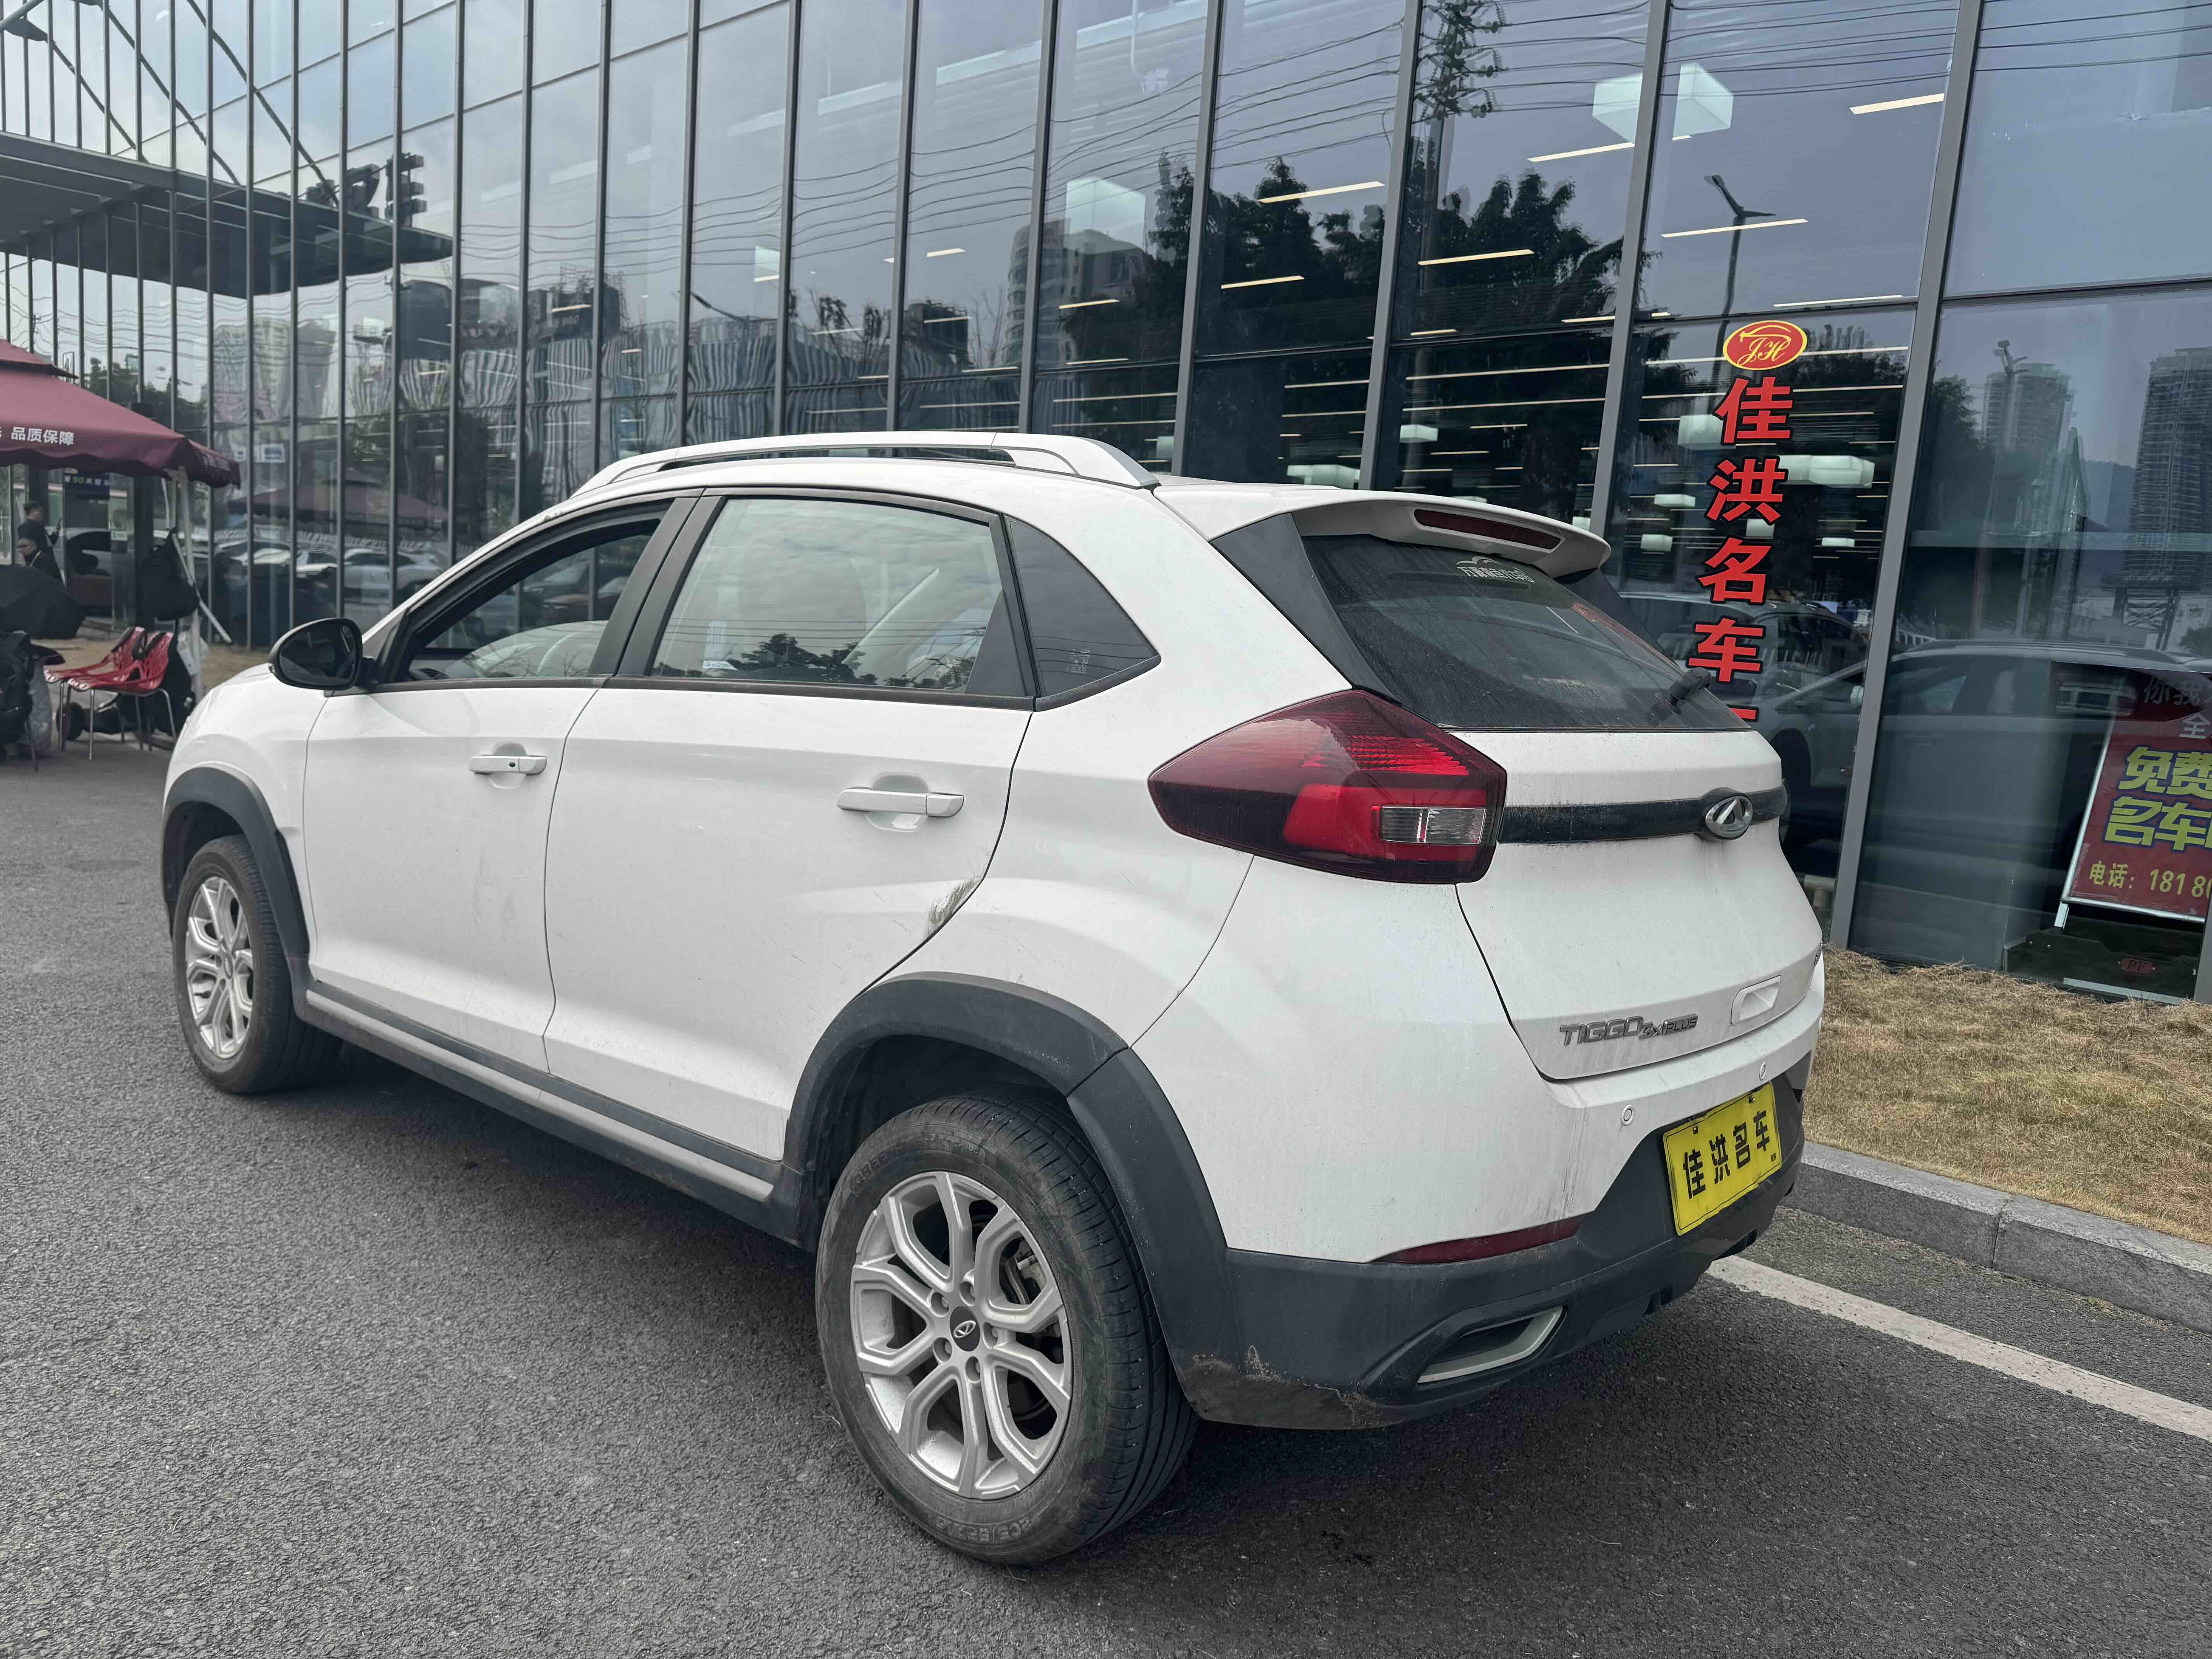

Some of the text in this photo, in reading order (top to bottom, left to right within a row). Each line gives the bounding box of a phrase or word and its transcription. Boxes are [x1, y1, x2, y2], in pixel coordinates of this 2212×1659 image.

[11, 426, 74, 445] 品质保障
[1688, 376, 1793, 720] 佳洪名车
[2144, 678, 2212, 707] 你我
[2179, 712, 2212, 739] 全
[2118, 747, 2212, 799] 免费
[2105, 796, 2212, 851] 名车
[1559, 1015, 1644, 1046] TIGGO
[1666, 1017, 1698, 1033] PLUS
[1683, 1110, 1770, 1199] 佳洪名车
